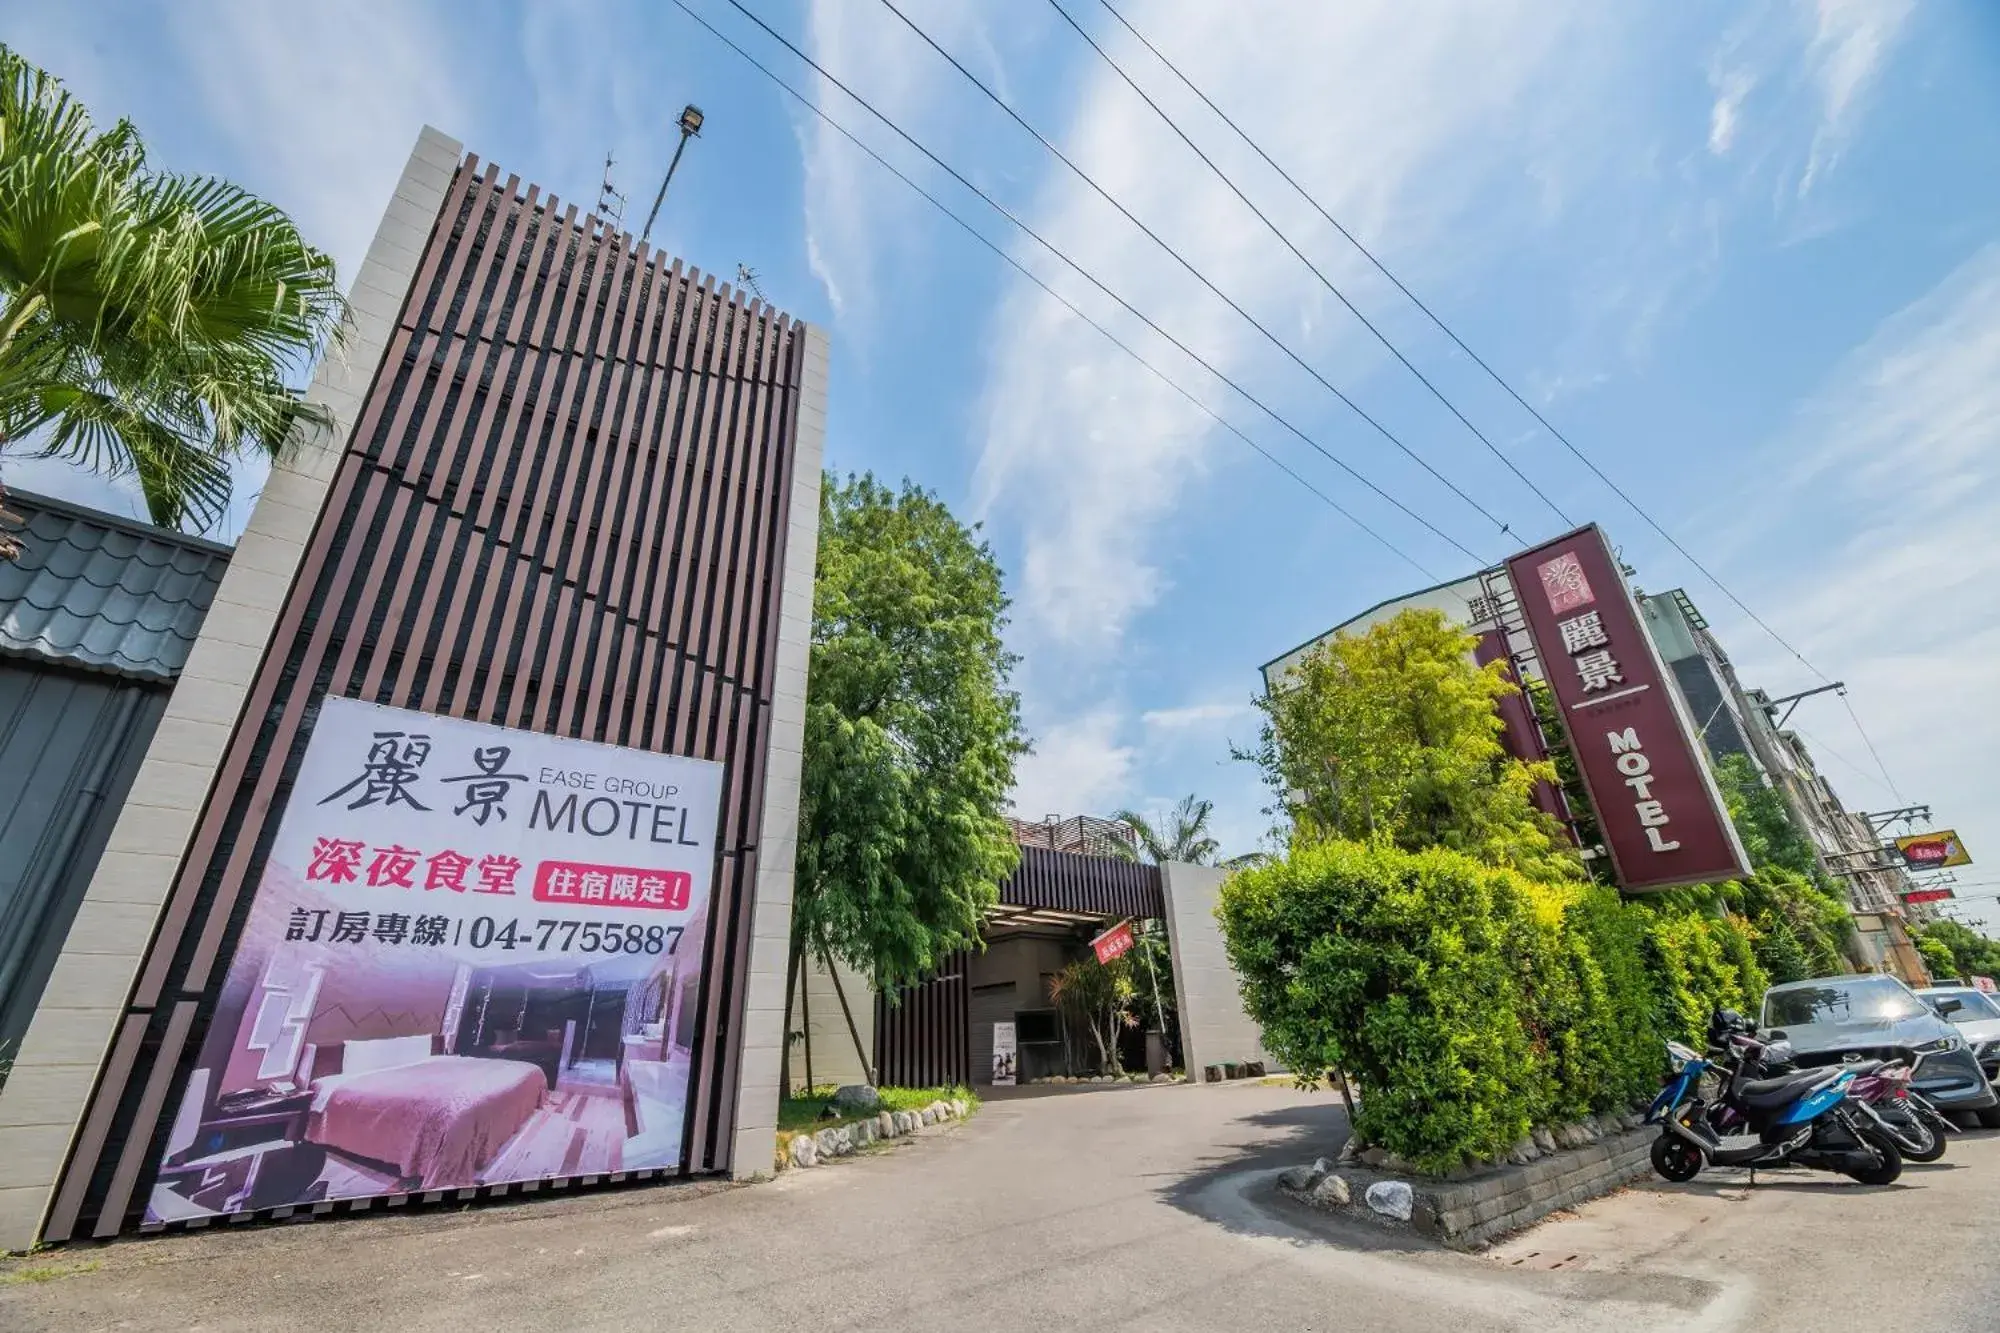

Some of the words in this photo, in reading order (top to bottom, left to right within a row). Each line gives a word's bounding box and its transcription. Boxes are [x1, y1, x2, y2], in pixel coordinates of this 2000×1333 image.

[1557, 610, 1623, 693] 麗景
[316, 731, 530, 827] 麗景
[539, 767, 598, 790] EASE
[604, 776, 679, 801] GROUP
[1606, 727, 1681, 852] MOTEL
[528, 789, 700, 847] MOTEL
[305, 836, 523, 896] 深夜食堂
[284, 906, 450, 947] 訂房專線
[469, 915, 686, 956] 04-7755887
